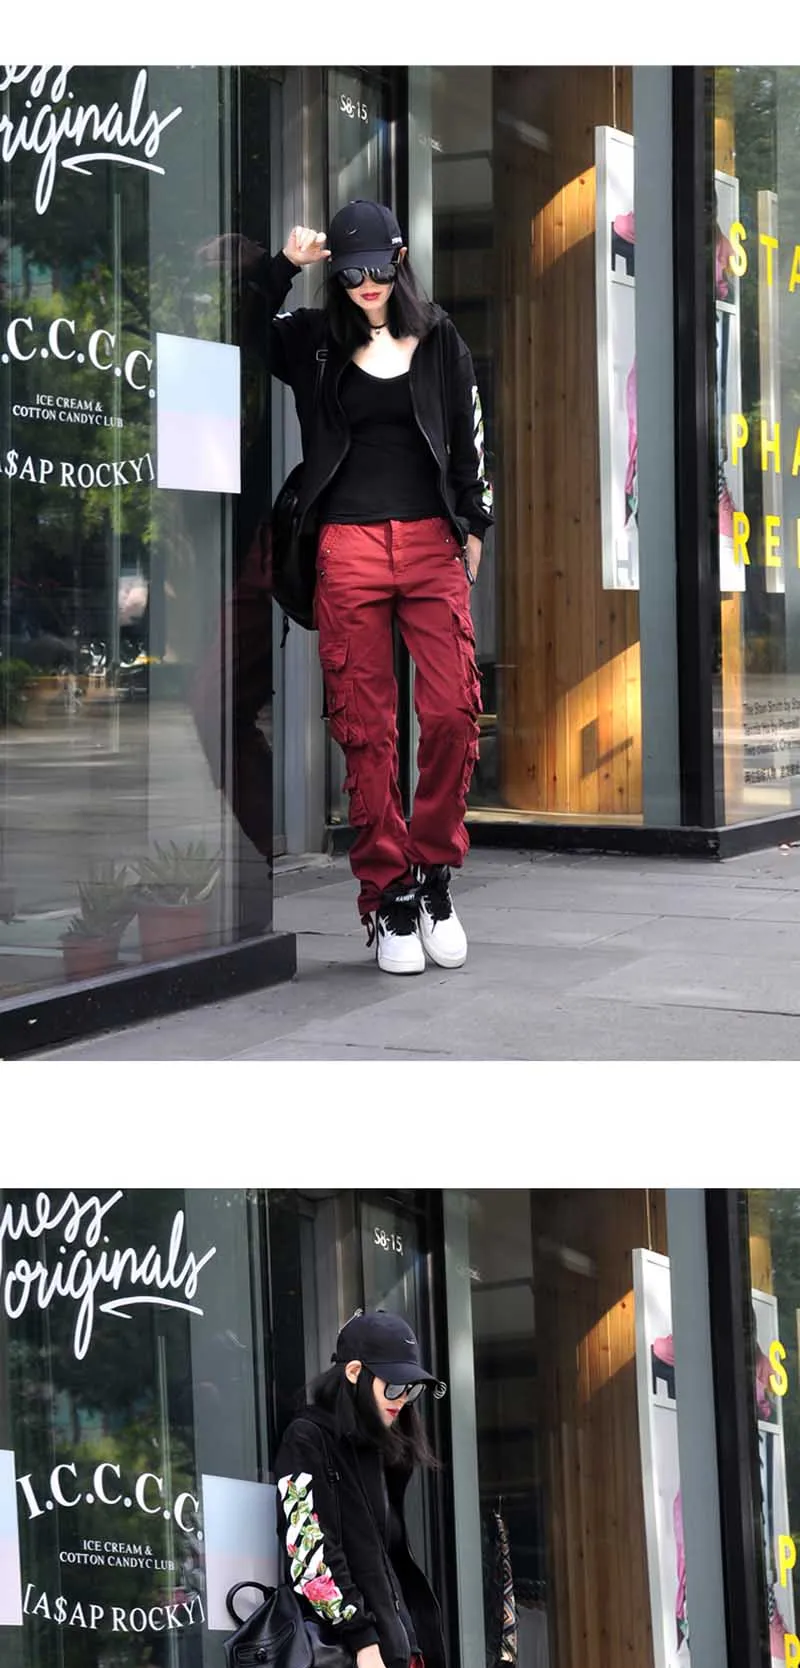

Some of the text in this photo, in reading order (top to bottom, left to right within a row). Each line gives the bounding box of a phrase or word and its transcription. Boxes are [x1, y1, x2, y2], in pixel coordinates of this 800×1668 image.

[0, 69, 182, 215] riginals
[12, 404, 56, 421] COTTON
[36, 393, 103, 412] ICE CREAM &
[0, 449, 53, 484] $AP
[0, 1190, 123, 1248] uess
[5, 1210, 216, 1360] originals
[16, 1462, 203, 1540] I.C.C.C.C.
[59, 1552, 104, 1565] COTTON
[83, 1540, 152, 1555] ICE CREAM &
[23, 1583, 104, 1629] [A$AP
